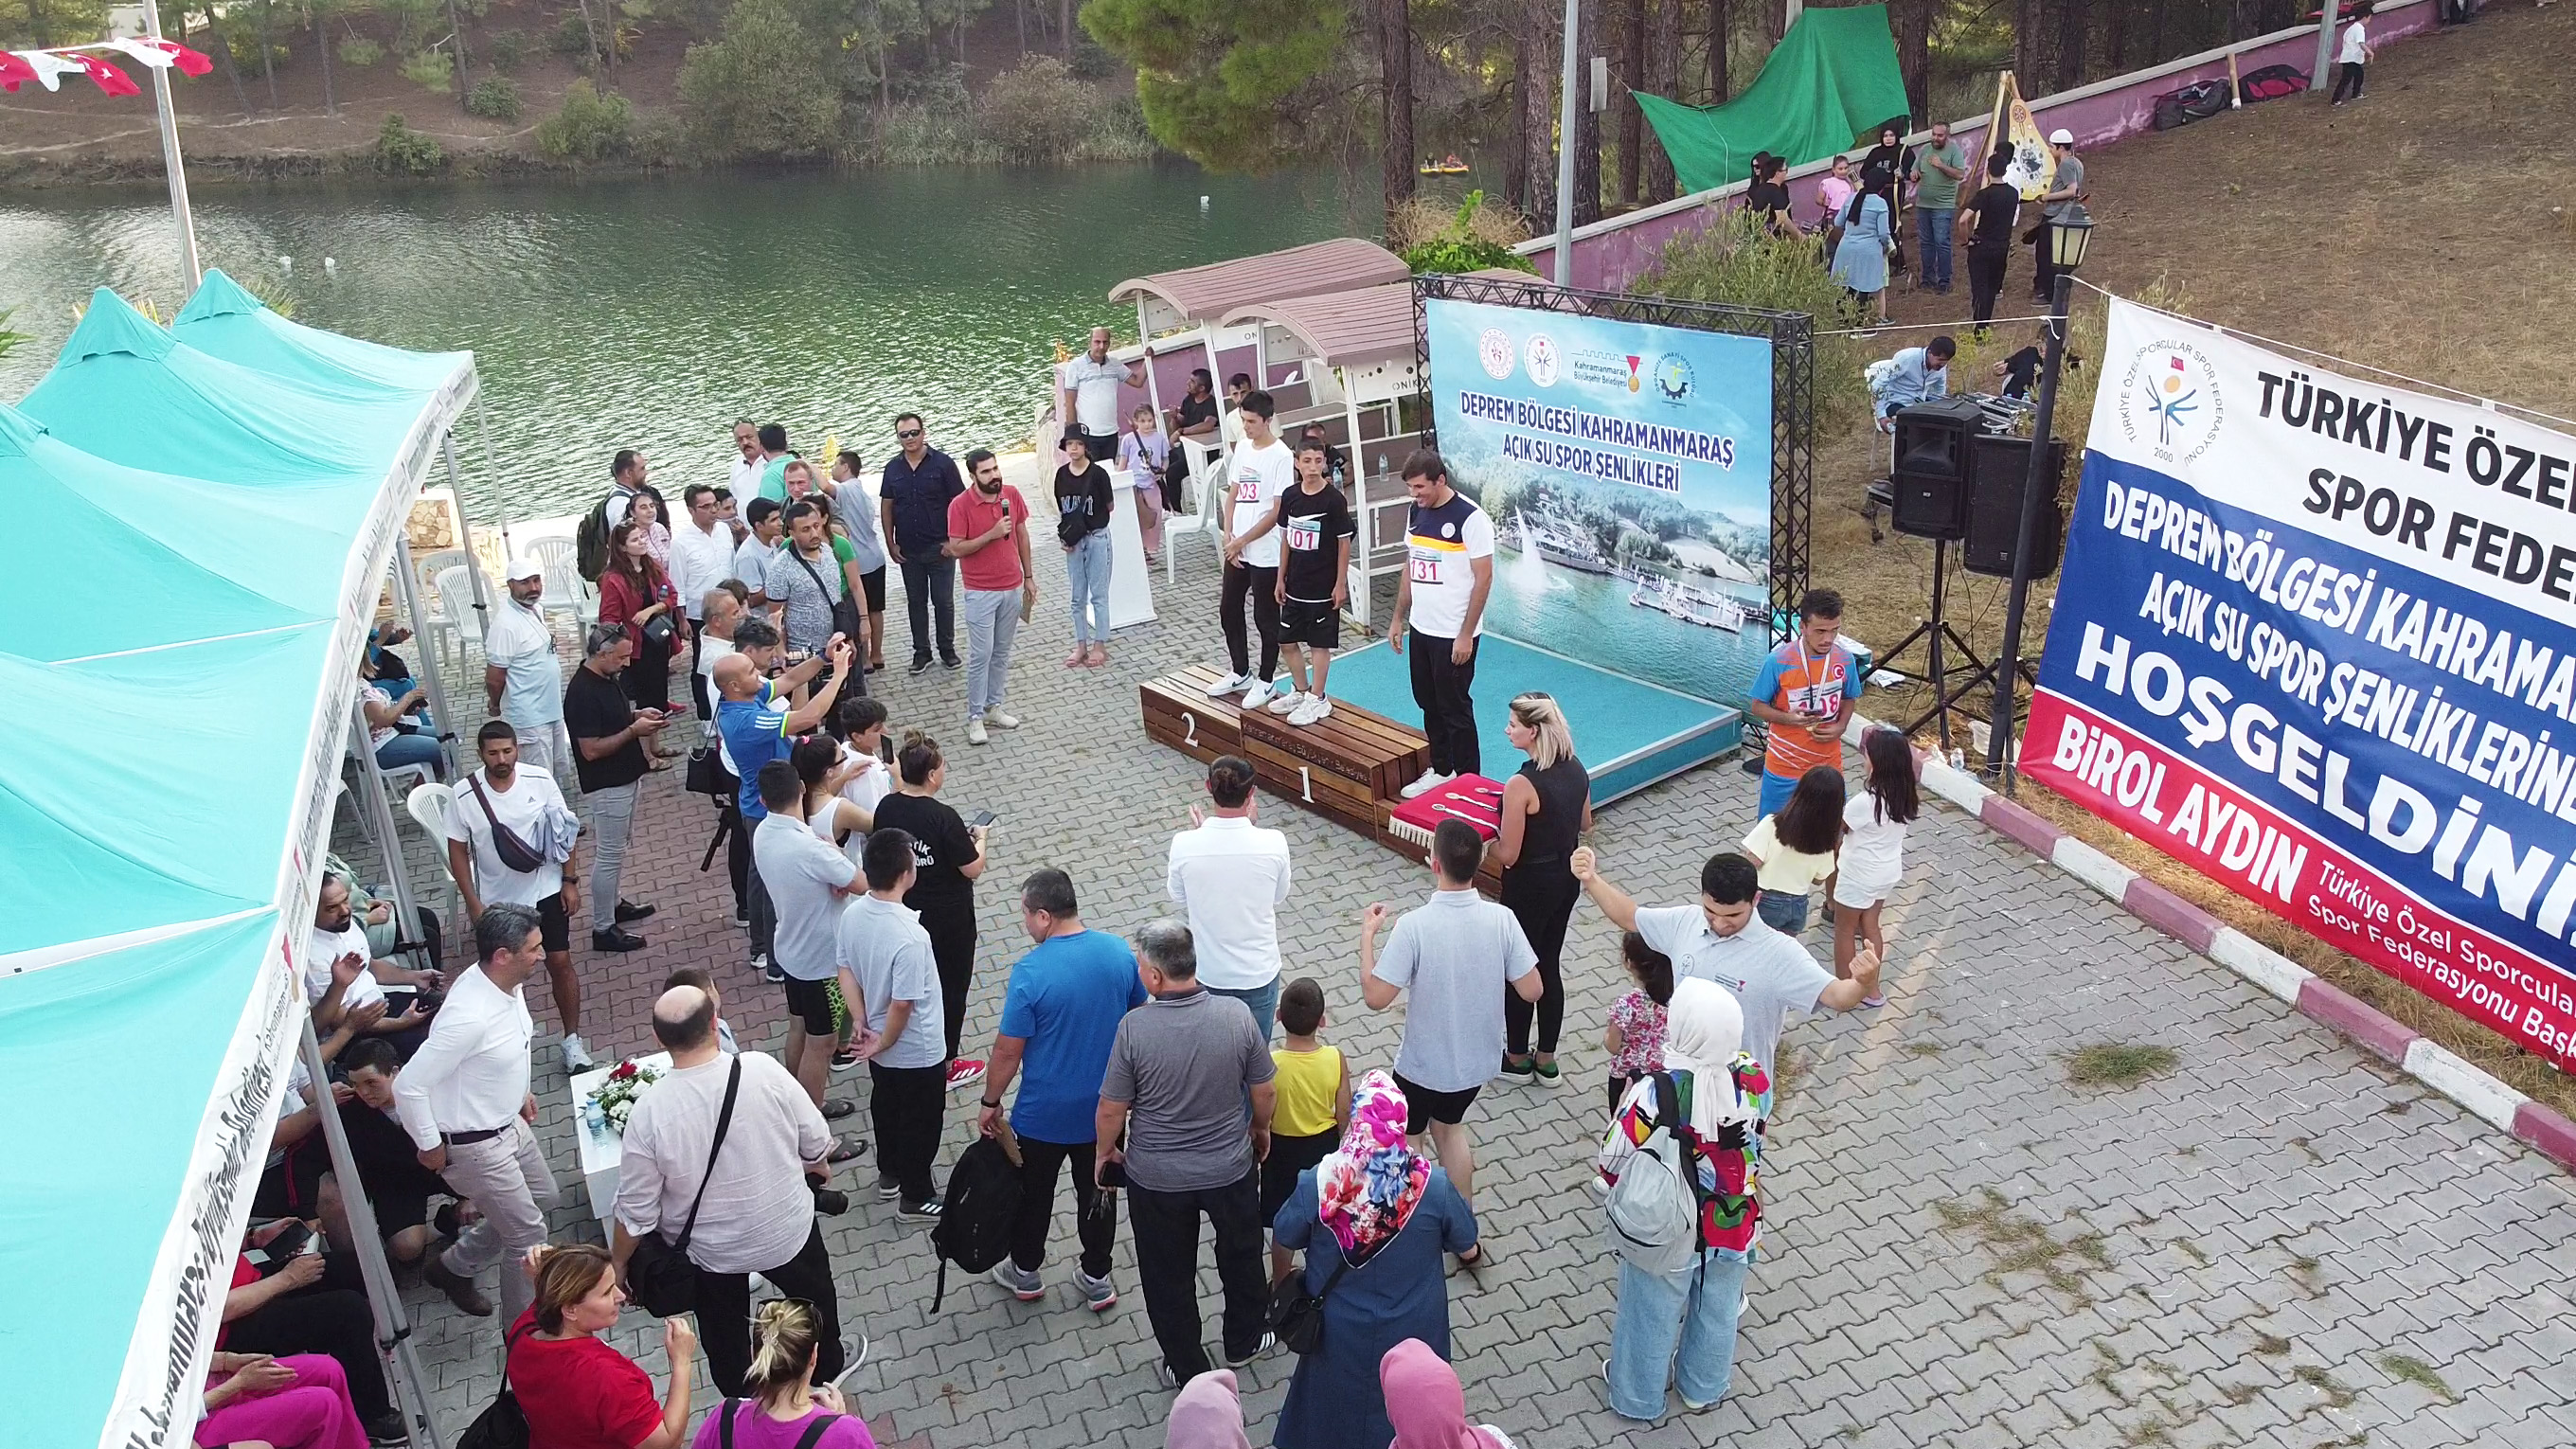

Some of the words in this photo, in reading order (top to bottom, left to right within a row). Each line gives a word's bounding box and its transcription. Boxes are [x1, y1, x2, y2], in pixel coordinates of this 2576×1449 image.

[1574, 360, 1627, 379] Kahramanmaraş
[2192, 350, 2216, 381] SPOR
[1461, 392, 1515, 424] DEPREM
[1518, 398, 1577, 436] BÖLGESİ
[1580, 414, 1733, 465] KAHRAMANMARAŞ
[1503, 434, 1531, 461] AÇIK
[1535, 439, 1552, 465] SU
[1555, 444, 1592, 474] SPOR
[1595, 451, 1680, 492] ŞENLİKLERİ
[2154, 447, 2174, 463] 2000
[2184, 381, 2225, 467] FEDERASYONU
[2257, 370, 2452, 473] TÜRKİYE
[1411, 560, 1437, 581] 131
[2301, 468, 2435, 551] SPOR
[2442, 511, 2576, 607] FEDE
[2103, 480, 2222, 572] DEPREM
[2225, 528, 2378, 635] BÖLGESİ
[2367, 591, 2576, 724] KAHRAMA
[2138, 571, 2212, 644] AÇIK
[2209, 601, 2249, 661] SU
[2246, 621, 2325, 706] SPOR
[1181, 711, 1199, 748] 2
[1298, 766, 1315, 803] 1
[2051, 713, 2169, 823] BİROL
[2167, 782, 2308, 903] AYDIN
[2075, 621, 2576, 948] HOŞGELDİNİ
[2308, 895, 2360, 936] Spor
[2368, 923, 2519, 1024] Federasyonu
[2318, 859, 2389, 925] Türkiye
[2395, 903, 2452, 953] Özel
[2460, 938, 2576, 1018] Sporcula
